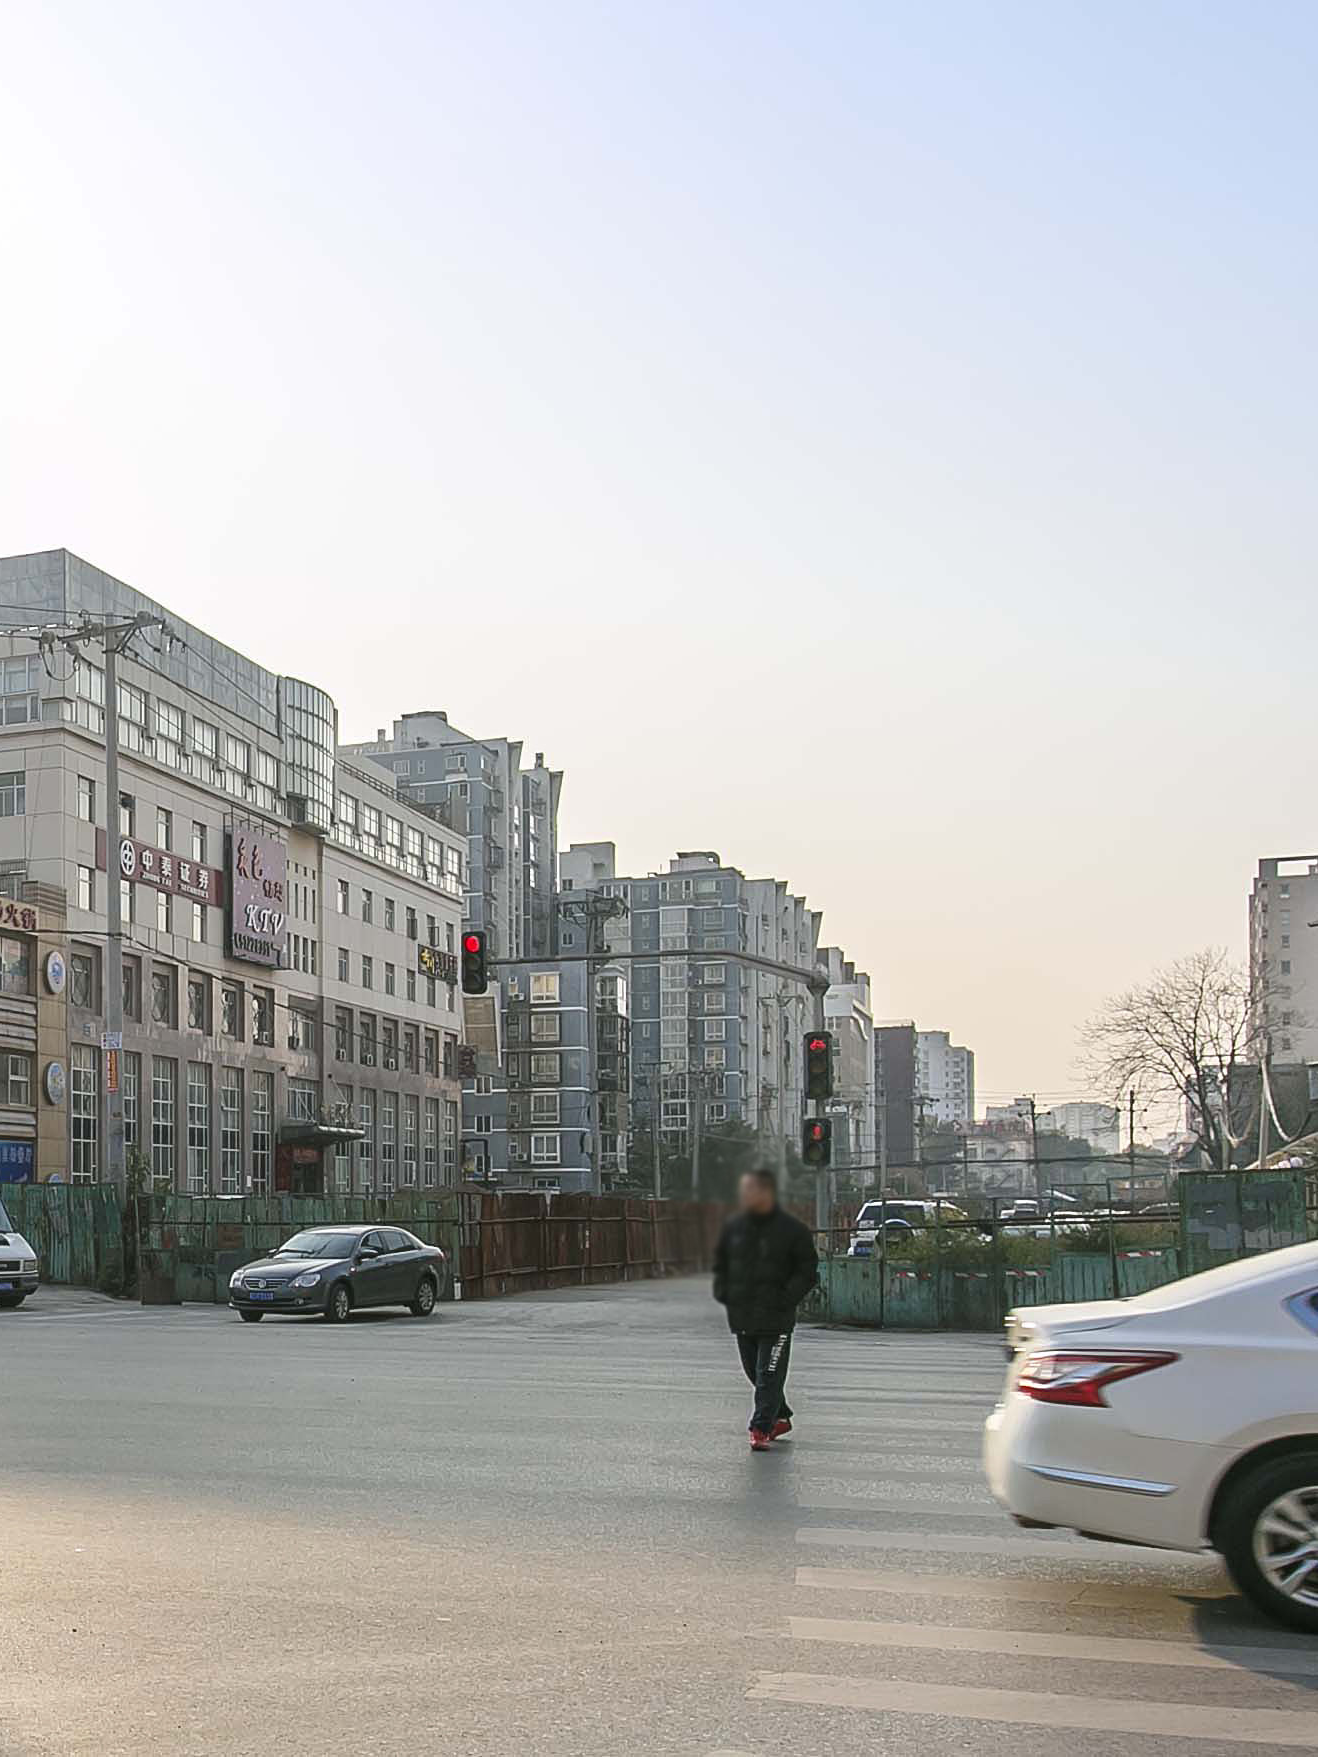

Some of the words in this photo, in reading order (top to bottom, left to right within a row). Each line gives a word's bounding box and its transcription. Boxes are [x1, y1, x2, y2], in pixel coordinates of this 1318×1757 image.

[142, 850, 209, 889] 中泰证券
[246, 904, 284, 935] KTV
